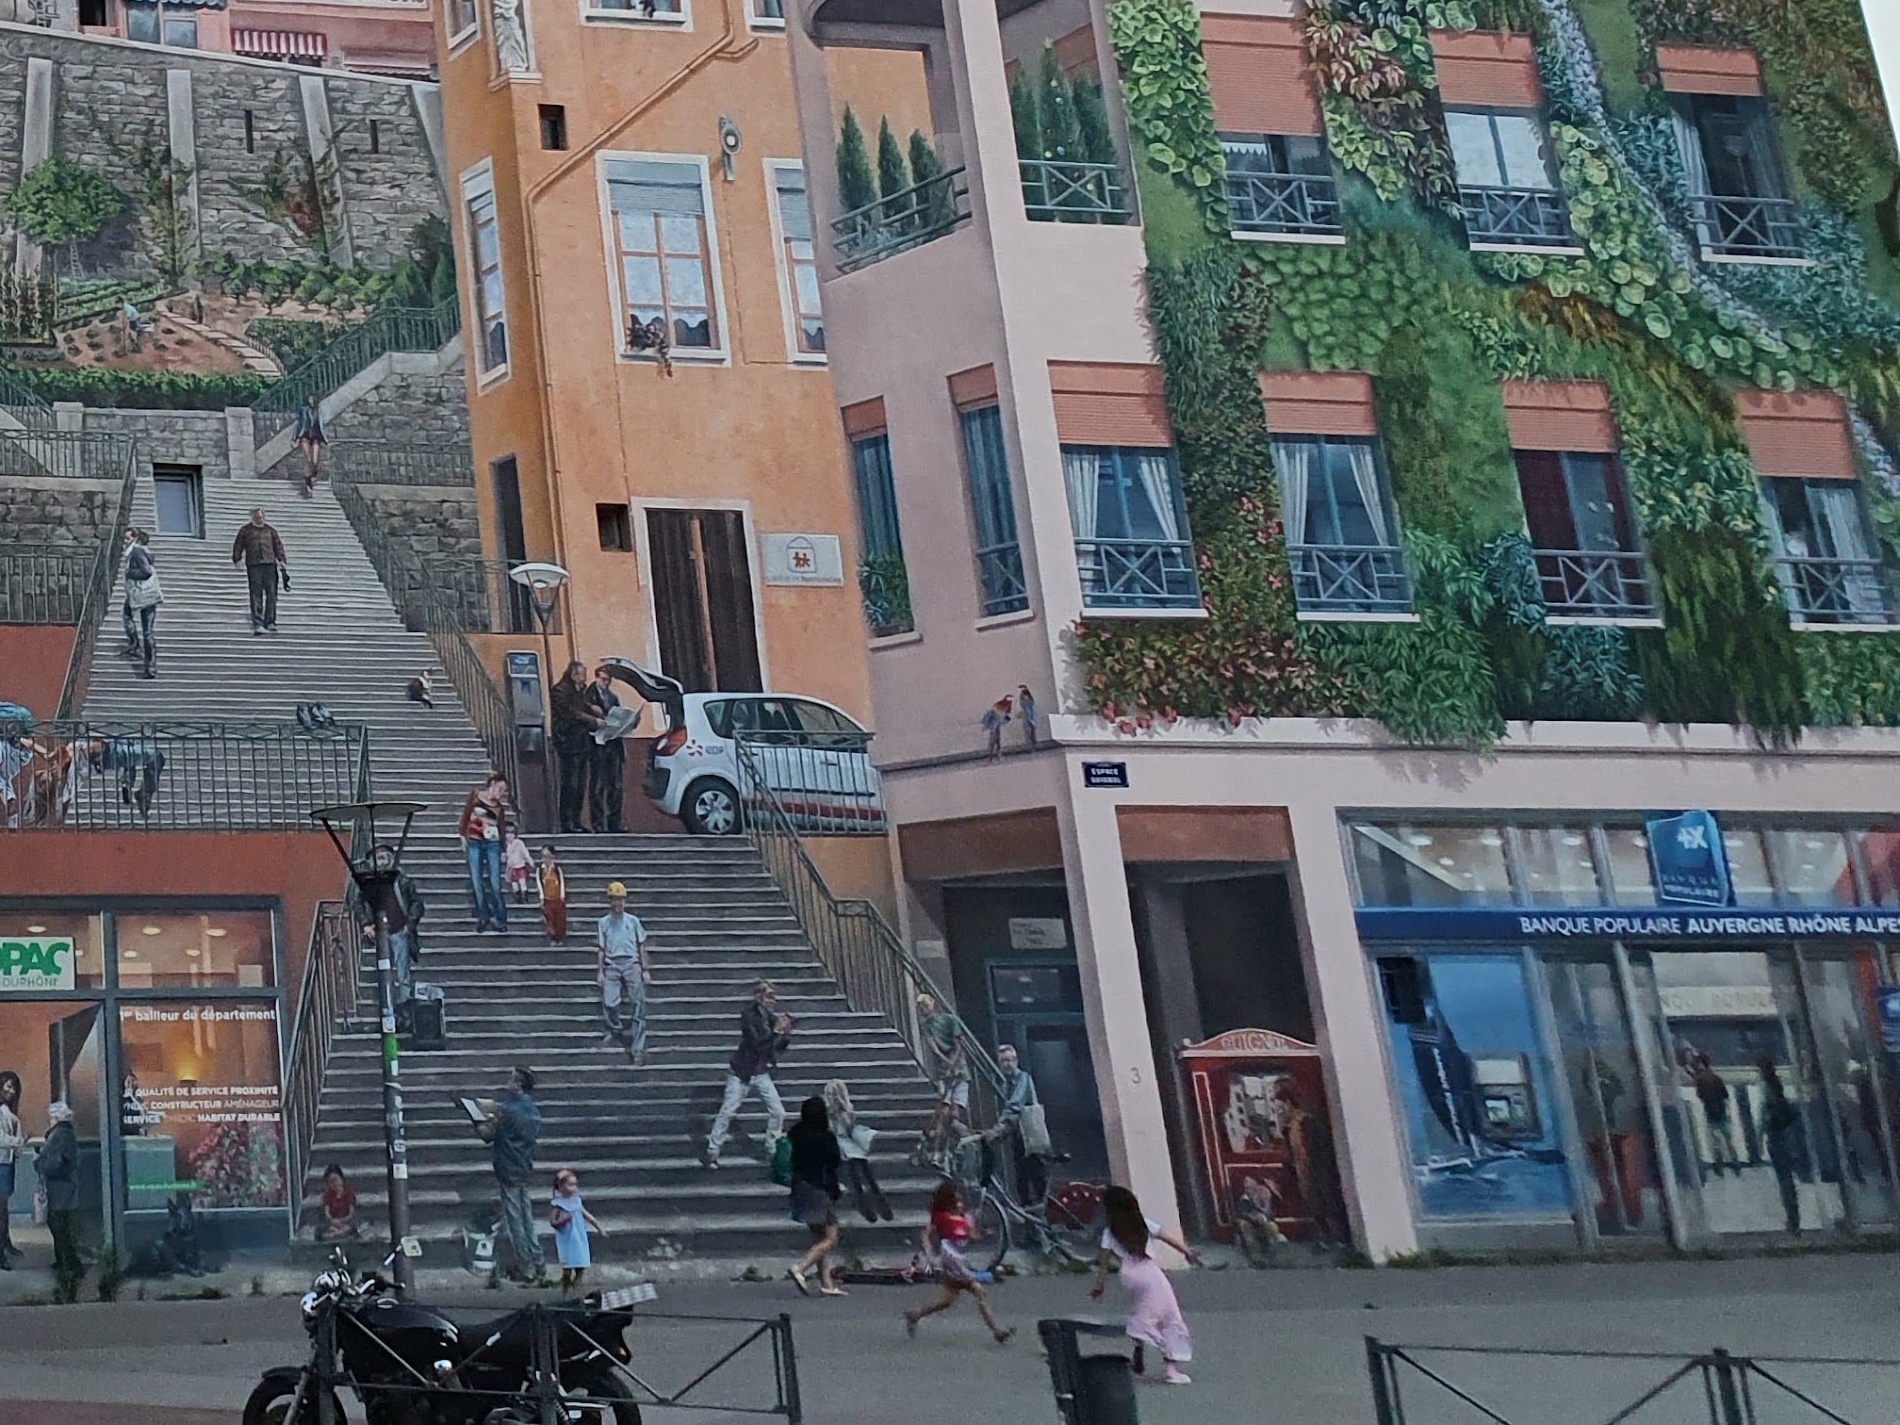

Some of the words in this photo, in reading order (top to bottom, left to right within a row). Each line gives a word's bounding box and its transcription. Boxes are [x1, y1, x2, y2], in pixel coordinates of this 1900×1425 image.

[1520, 917, 1593, 936] BANQUE
[1594, 917, 1681, 935] POPULAIRE
[1687, 917, 1785, 935] AUVERGNE
[1787, 913, 1851, 935] RHÔNE
[135, 1010, 179, 1021] bailleur
[183, 1010, 196, 1021] du
[201, 1009, 275, 1022] département
[1131, 1067, 1141, 1084] 3
[191, 1087, 228, 1096] SERVICE
[151, 1100, 222, 1110] CONSTRUCTEUR
[198, 1113, 236, 1122] HABITAT
[238, 1113, 280, 1122] DURABLE
